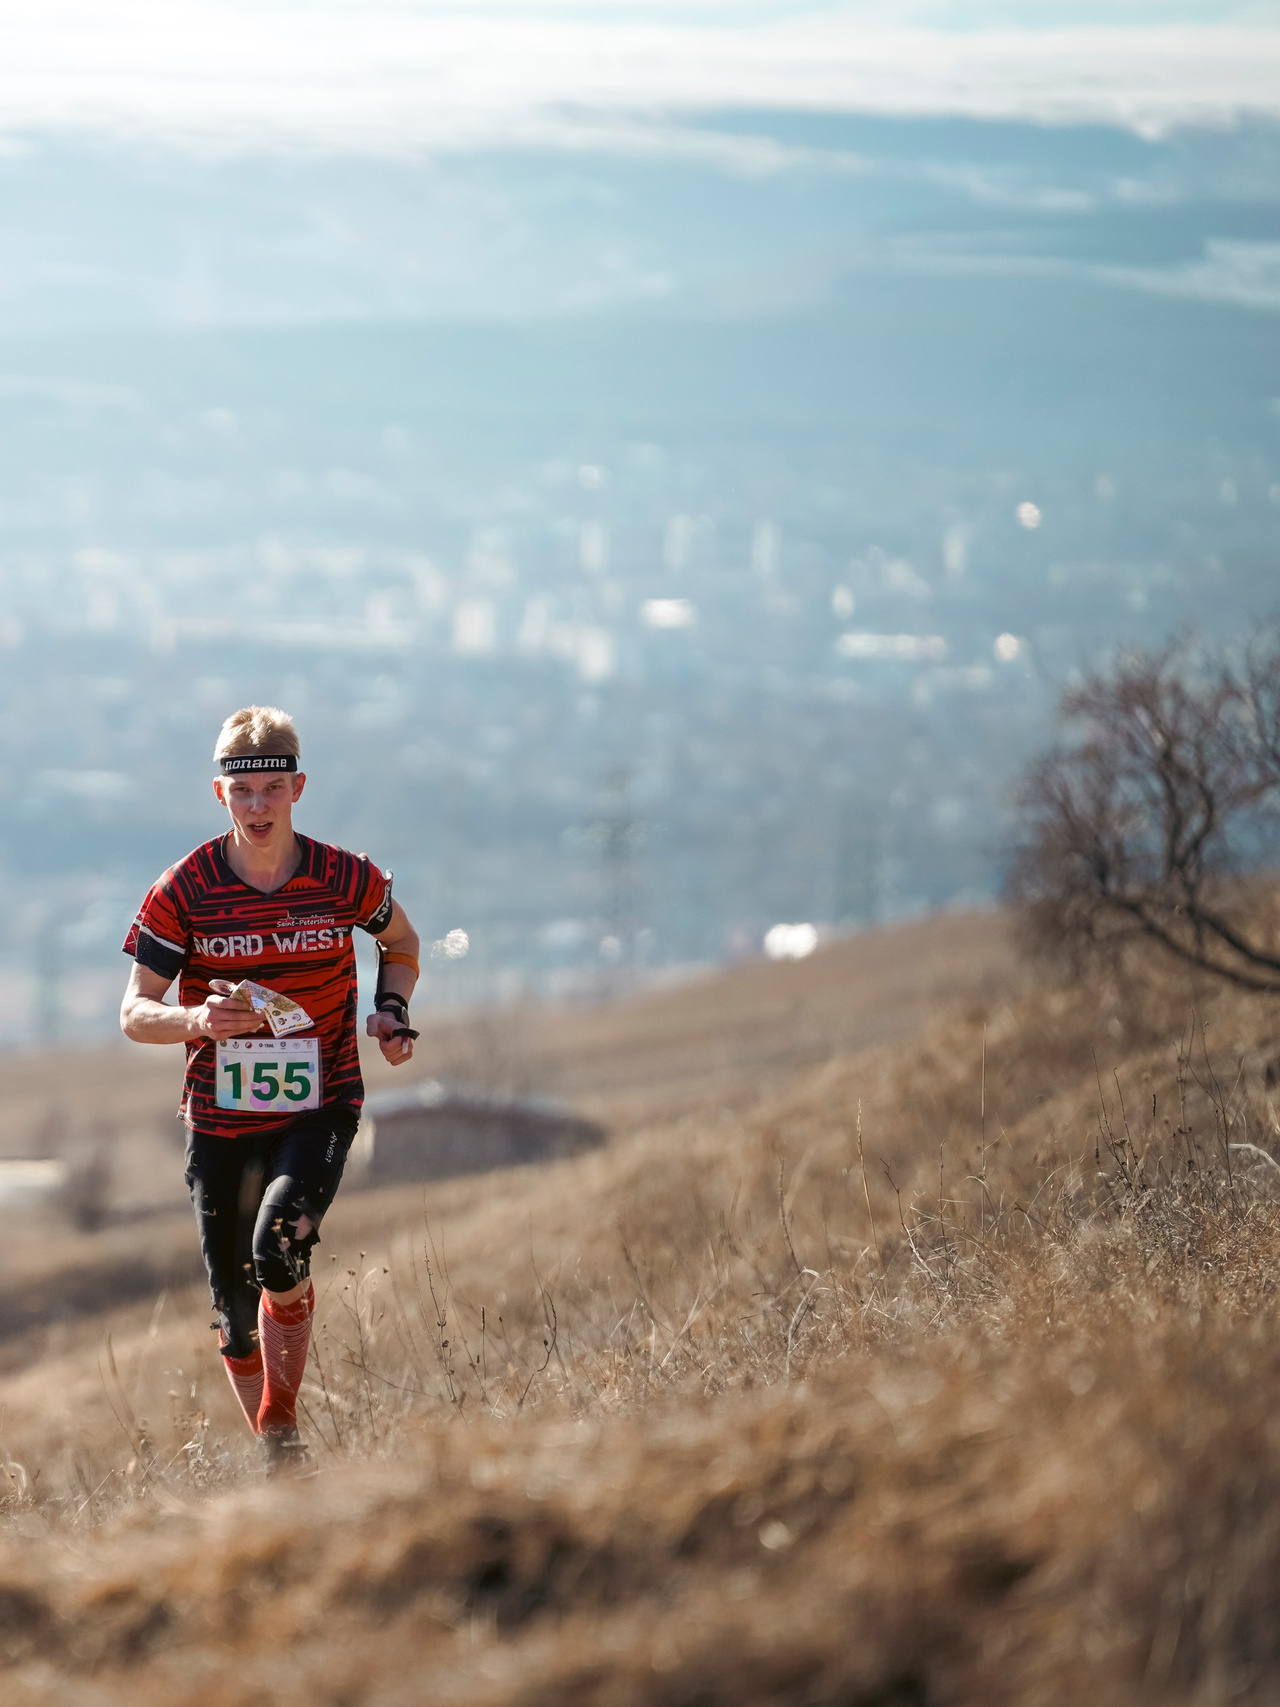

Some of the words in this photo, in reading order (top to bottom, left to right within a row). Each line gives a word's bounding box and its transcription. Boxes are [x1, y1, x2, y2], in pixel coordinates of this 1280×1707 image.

[225, 758, 287, 771] noname
[276, 917, 335, 928] Saint-Petersburg
[193, 934, 264, 958] NORD
[271, 926, 349, 953] WEST
[223, 1061, 311, 1102] 155
